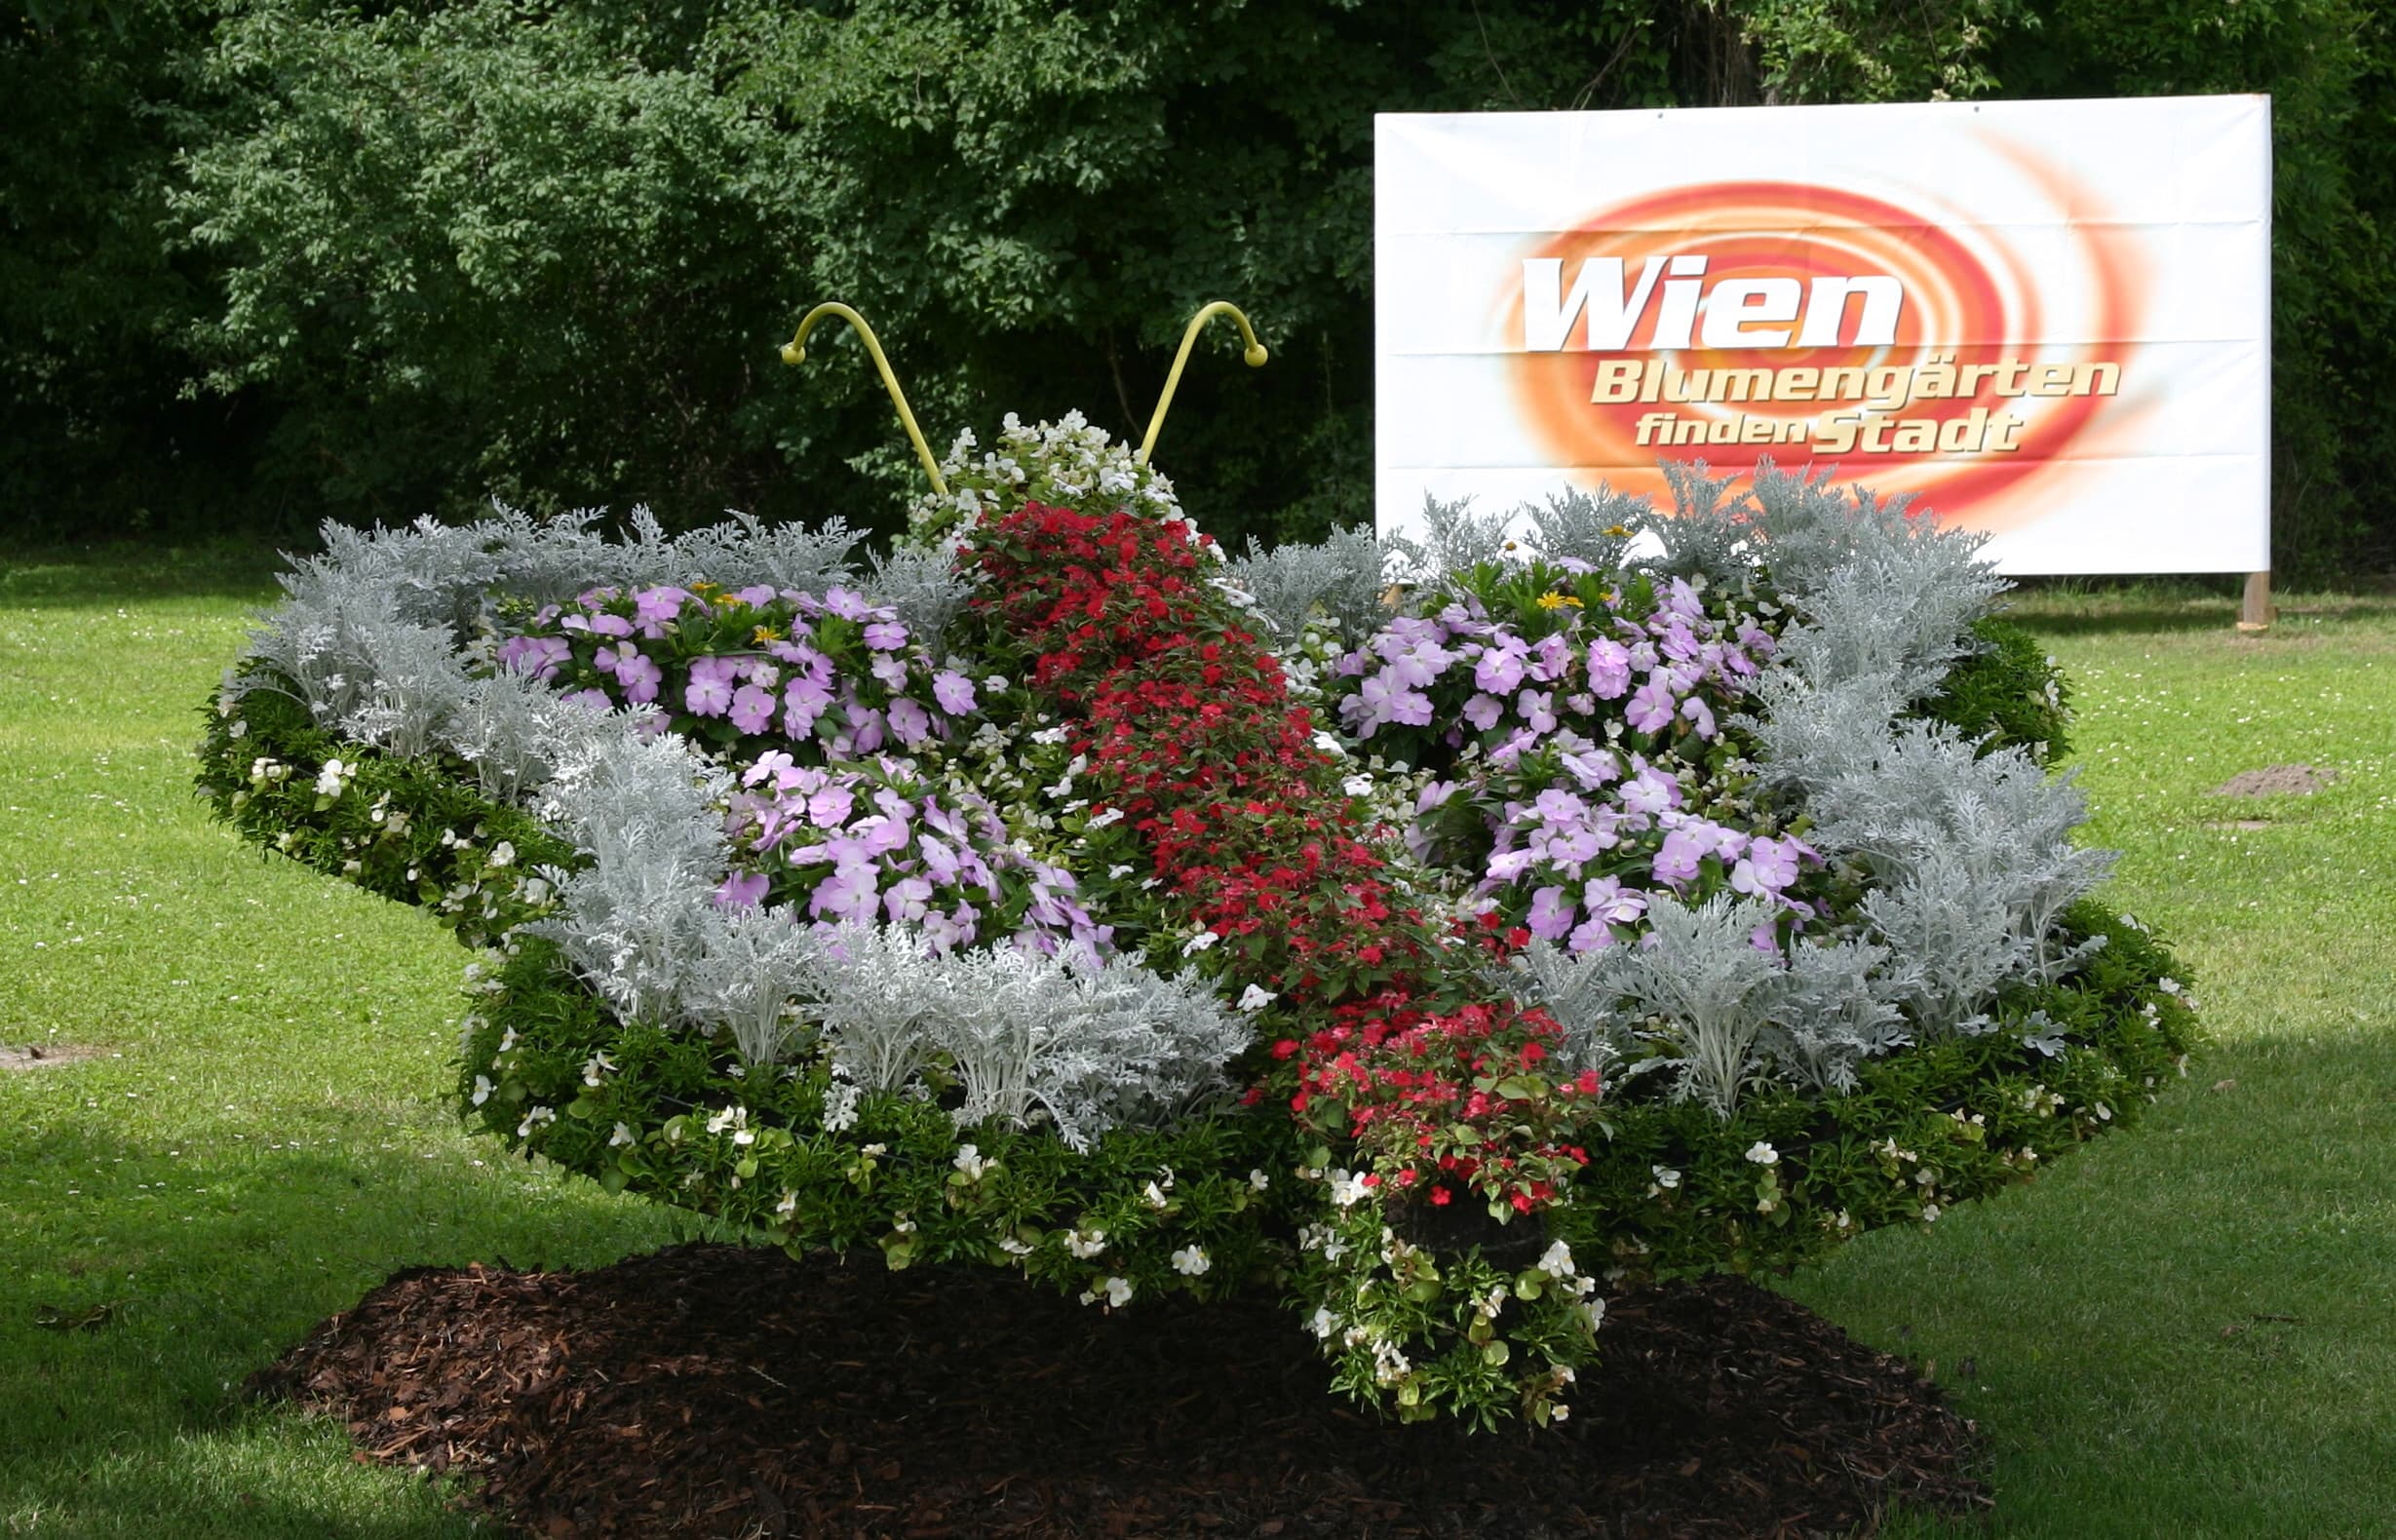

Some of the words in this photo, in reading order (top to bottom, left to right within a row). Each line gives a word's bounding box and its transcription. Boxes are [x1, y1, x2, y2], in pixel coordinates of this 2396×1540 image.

[1523, 254, 1904, 352] Wien
[1591, 356, 2120, 408] Blumengärten
[1636, 413, 1809, 445] finden
[1811, 408, 2023, 454] Stadt
